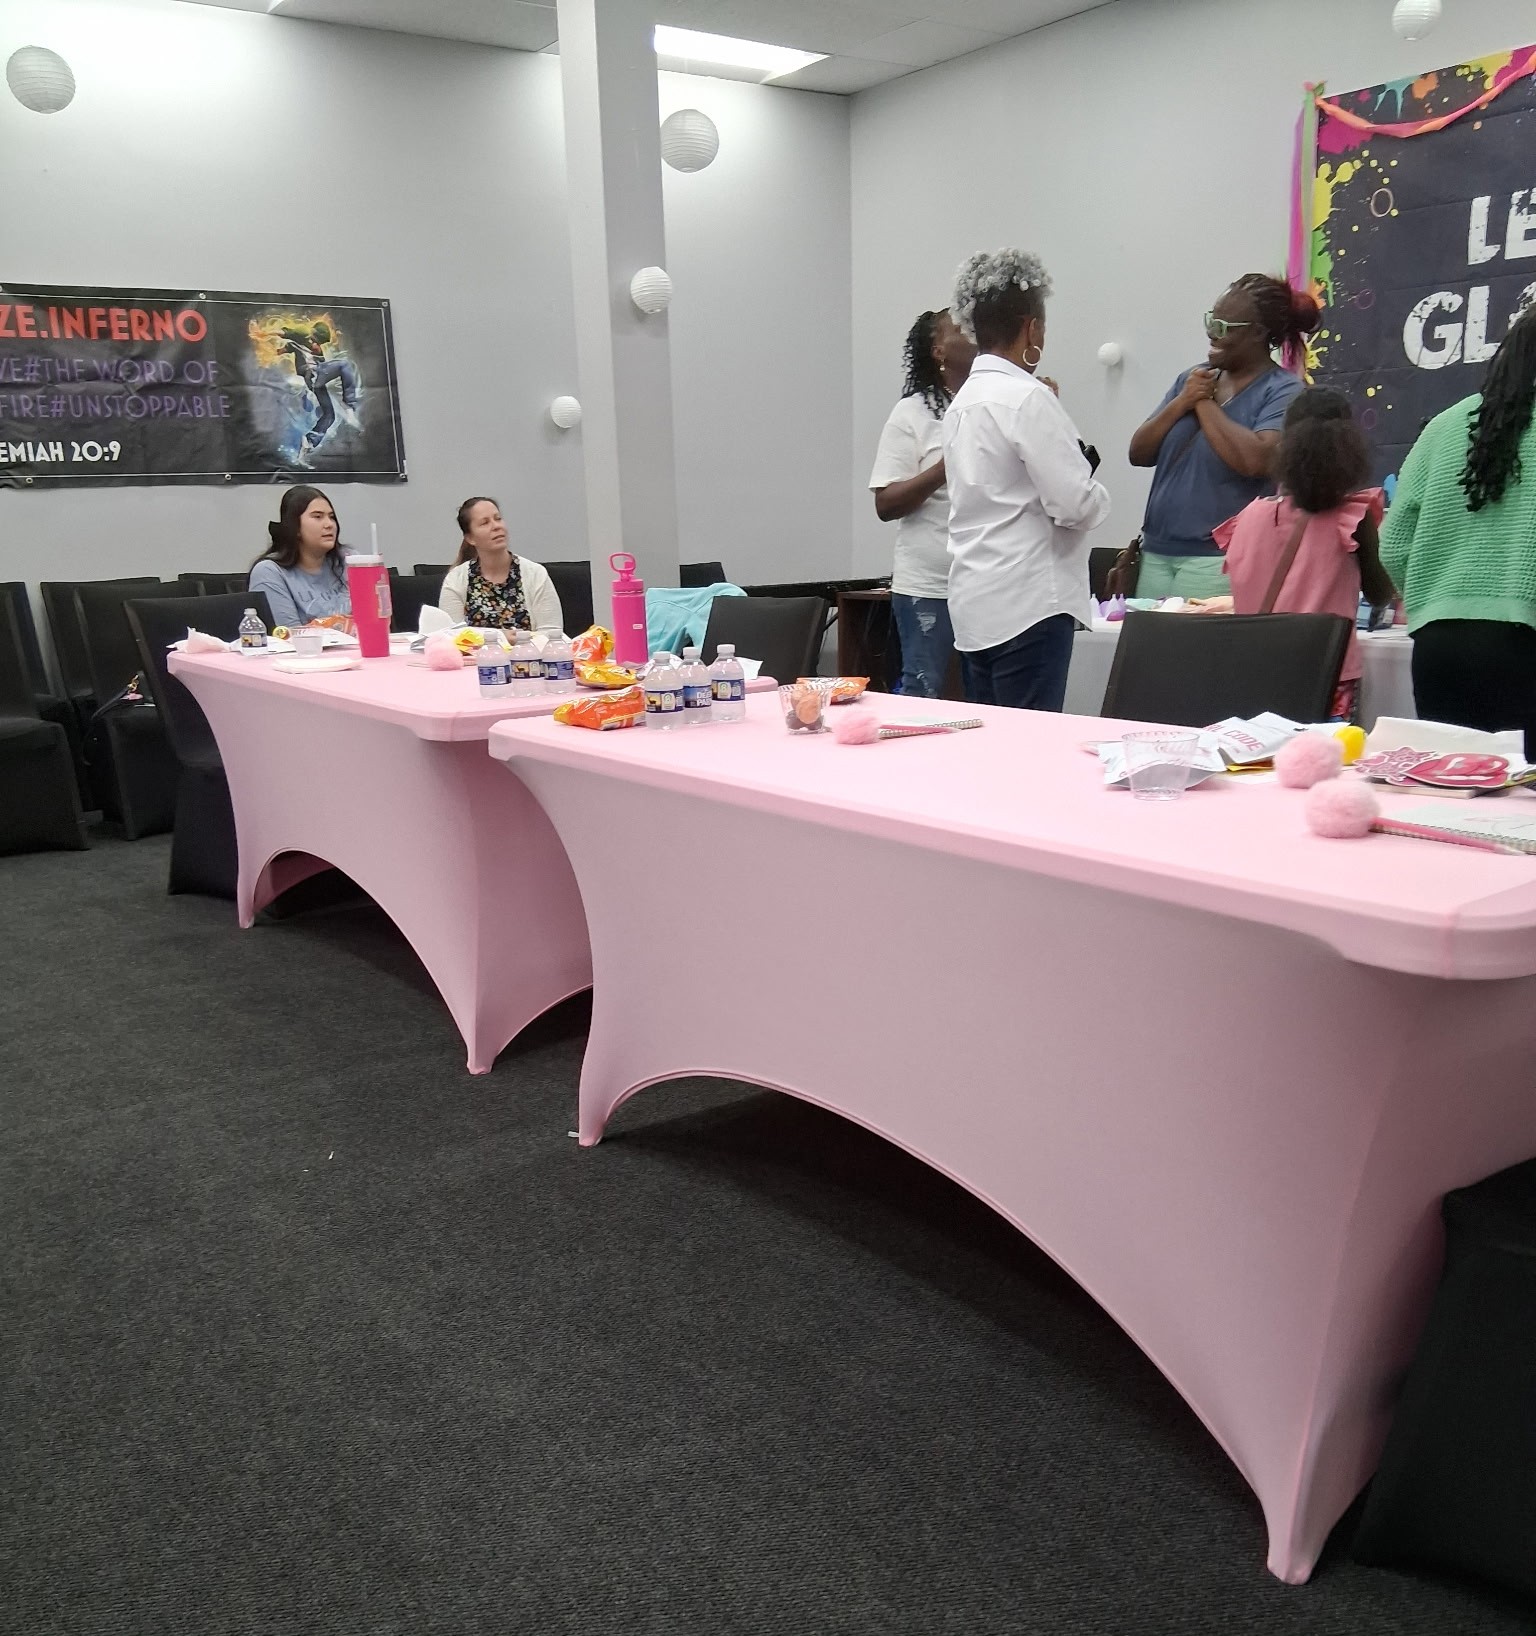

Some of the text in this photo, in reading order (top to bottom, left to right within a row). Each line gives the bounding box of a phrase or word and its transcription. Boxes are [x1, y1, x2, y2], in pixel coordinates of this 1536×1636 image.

[1403, 280, 1536, 370] GL
[92, 358, 174, 383] WORD
[183, 360, 219, 384] OF
[0, 394, 231, 418] FIRE#UNSTOPPABLE
[70, 440, 121, 462] 20:9
[1222, 729, 1266, 752] CODE
